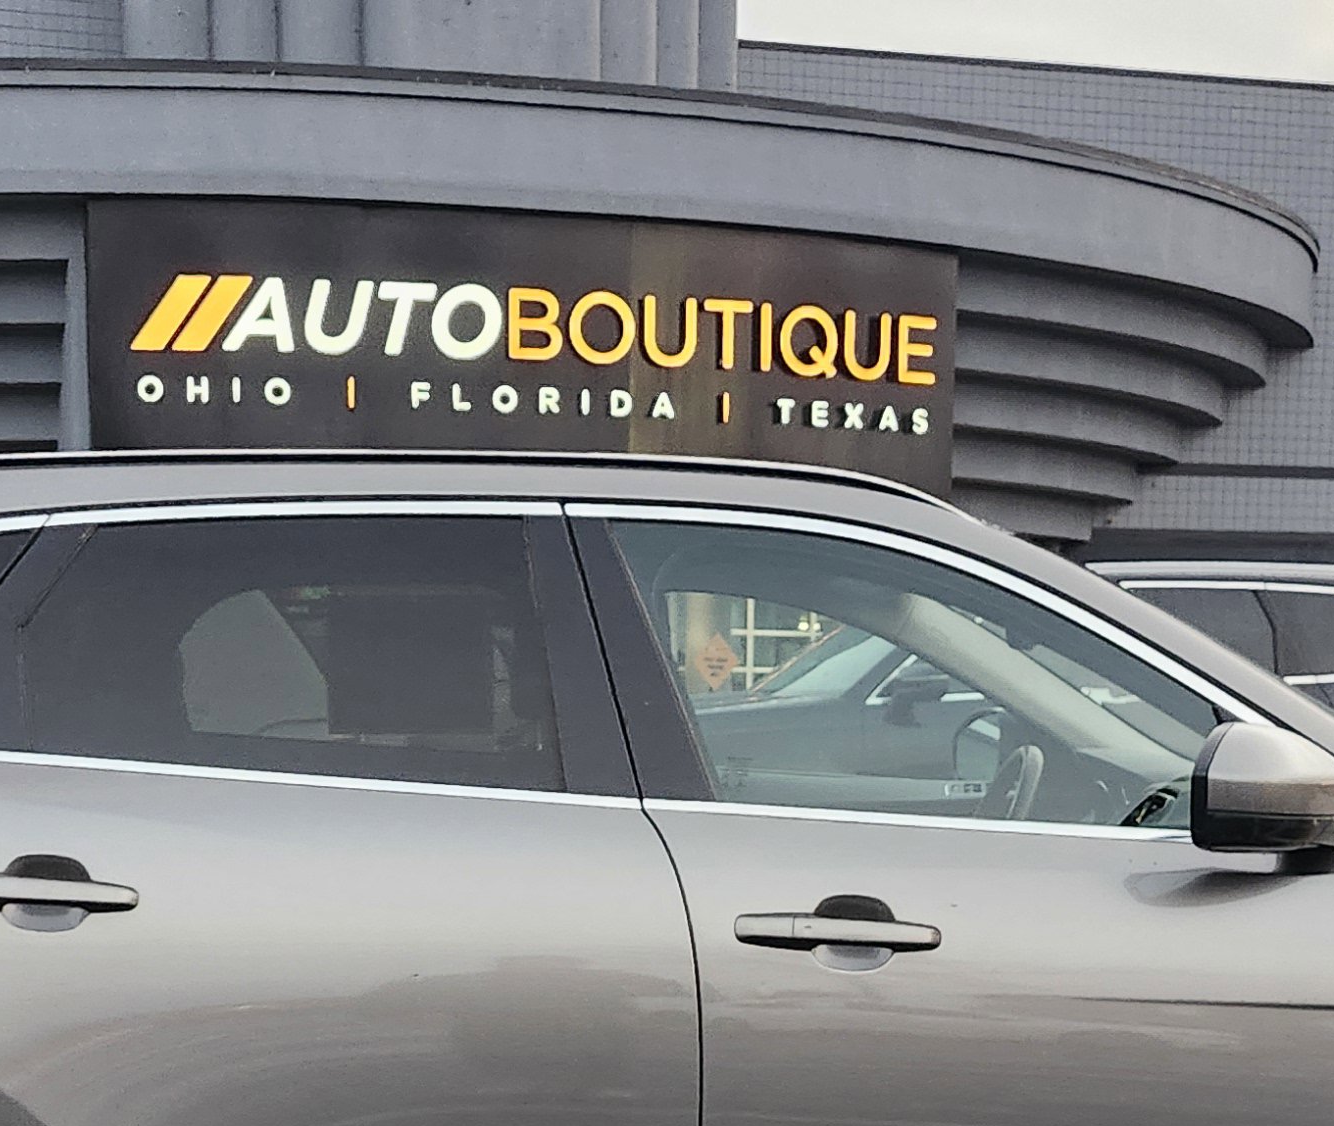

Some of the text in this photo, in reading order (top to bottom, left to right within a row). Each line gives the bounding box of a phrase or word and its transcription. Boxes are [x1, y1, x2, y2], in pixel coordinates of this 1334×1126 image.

[137, 374, 929, 436] OHIO FLORIDA TEXAS
